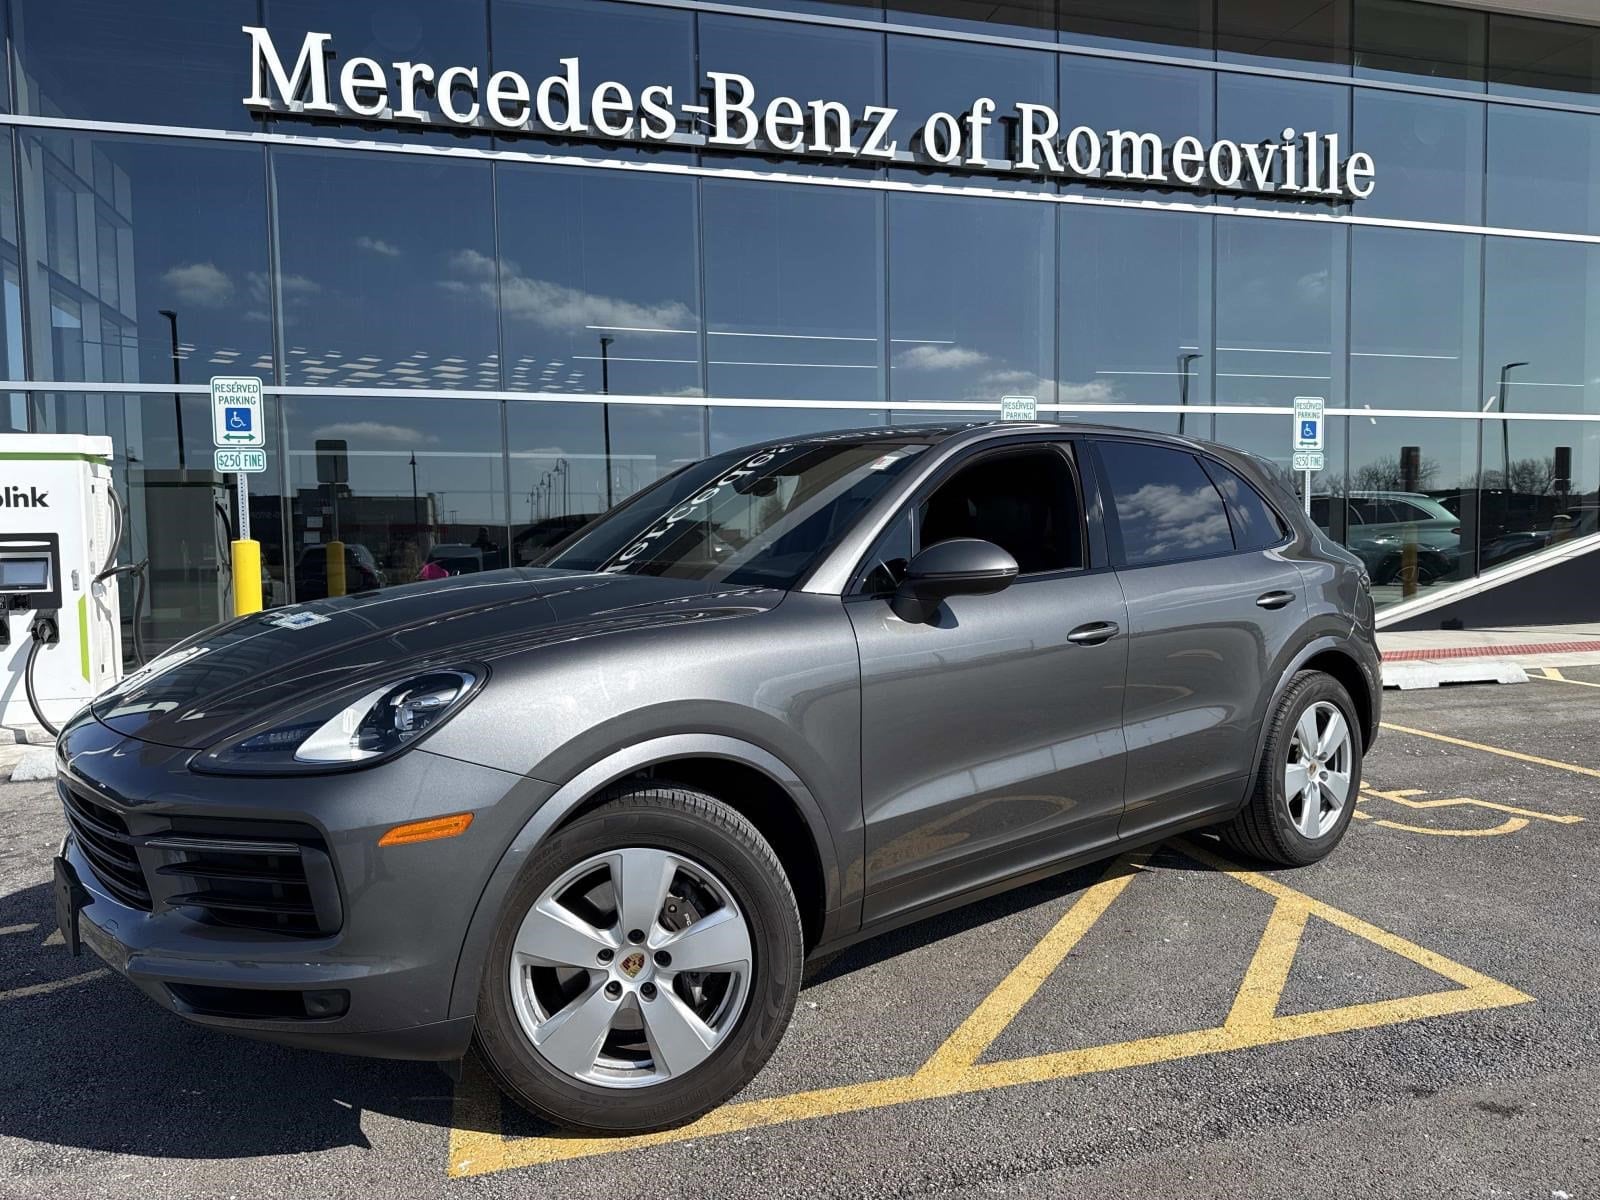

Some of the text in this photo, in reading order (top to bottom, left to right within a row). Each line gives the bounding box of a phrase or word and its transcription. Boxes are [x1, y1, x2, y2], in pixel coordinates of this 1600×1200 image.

[242, 26, 1376, 198] Mercedes-Benz of Romeoville
[215, 383, 258, 394] RESERVED
[218, 395, 257, 405] PARKING
[1004, 401, 1034, 410] RESERVED
[1005, 411, 1032, 420] PARKING
[1297, 411, 1321, 419] PARKING
[219, 454, 263, 467] $250 FINE
[1296, 456, 1321, 467] $250 FINE
[0, 485, 50, 508] link
